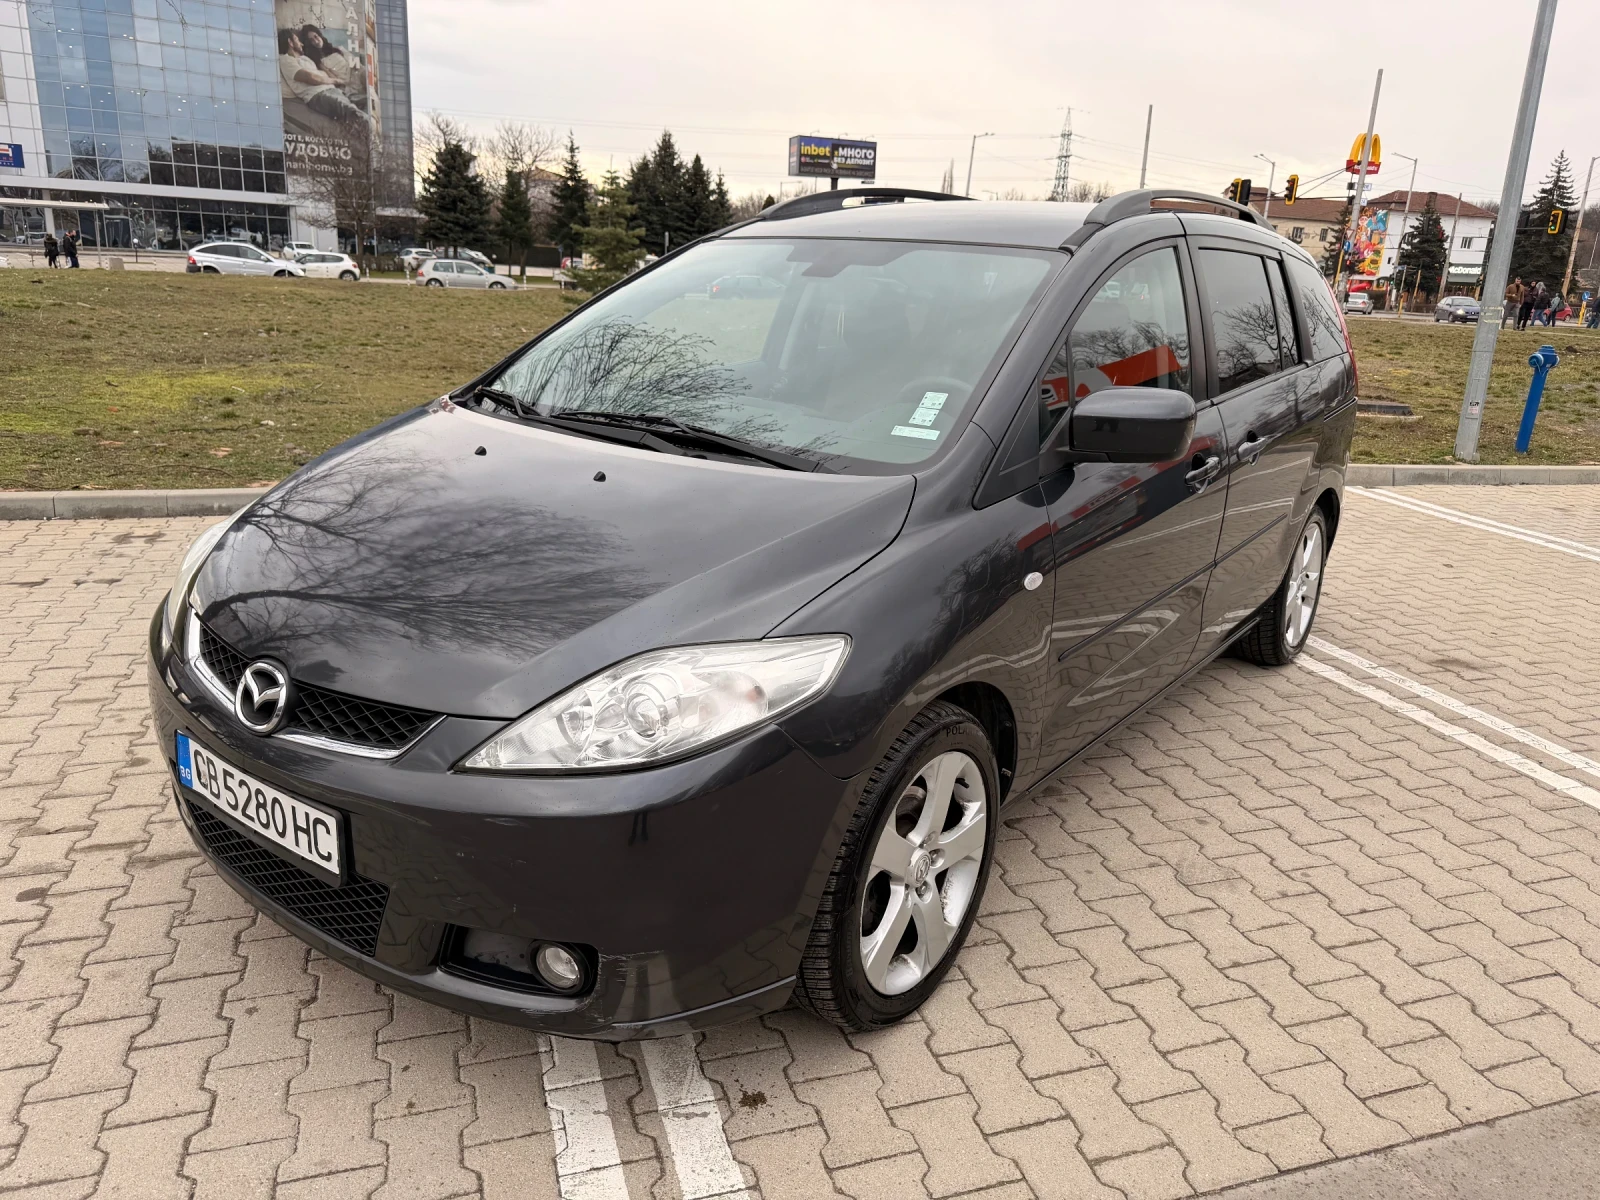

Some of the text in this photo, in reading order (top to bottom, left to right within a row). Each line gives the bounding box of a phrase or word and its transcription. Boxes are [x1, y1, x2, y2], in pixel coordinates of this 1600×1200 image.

[346, 0, 360, 69] АЛНИ
[285, 142, 352, 160] УДОБНО
[801, 142, 830, 157] inbet
[839, 147, 874, 160] МНОГО
[846, 158, 875, 167] ДЕПОЗИТ
[180, 765, 191, 779] BG
[223, 768, 287, 839] 5280
[291, 805, 332, 863] HC
